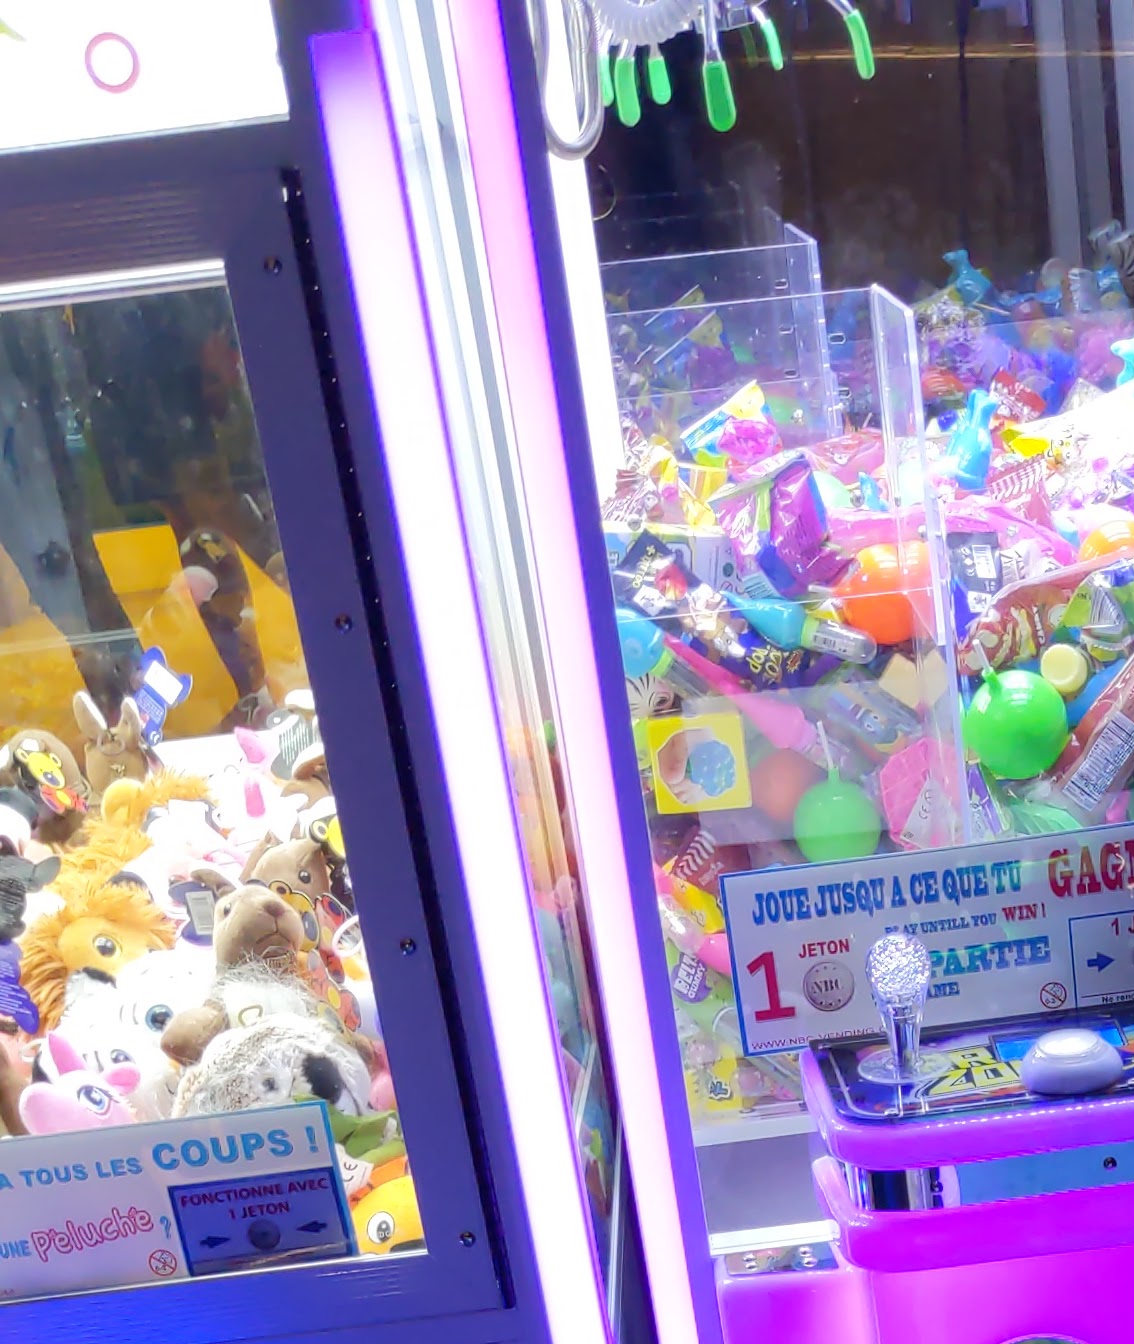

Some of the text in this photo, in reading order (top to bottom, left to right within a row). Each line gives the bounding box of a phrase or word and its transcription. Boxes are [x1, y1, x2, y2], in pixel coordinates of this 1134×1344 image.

[752, 887, 811, 926] JOUE
[814, 877, 885, 918] JUSQU
[892, 874, 907, 908] A
[910, 871, 940, 905] CE
[942, 864, 989, 905] QUE
[991, 860, 1022, 893] TU
[921, 915, 970, 934] UNTILL
[971, 913, 997, 927] YOU
[1002, 903, 1037, 922] WIN
[1111, 918, 1120, 936] 1
[929, 935, 1051, 978] PARTIE
[746, 938, 850, 1023] 1 JETON
[927, 981, 960, 999] AME
[19, 1163, 89, 1188] TOUS
[94, 1156, 143, 1179] LES
[152, 1129, 294, 1172] COUPS
[180, 1176, 330, 1209] FONCTIONNE AVEC
[229, 1201, 291, 1219] 1 JETON
